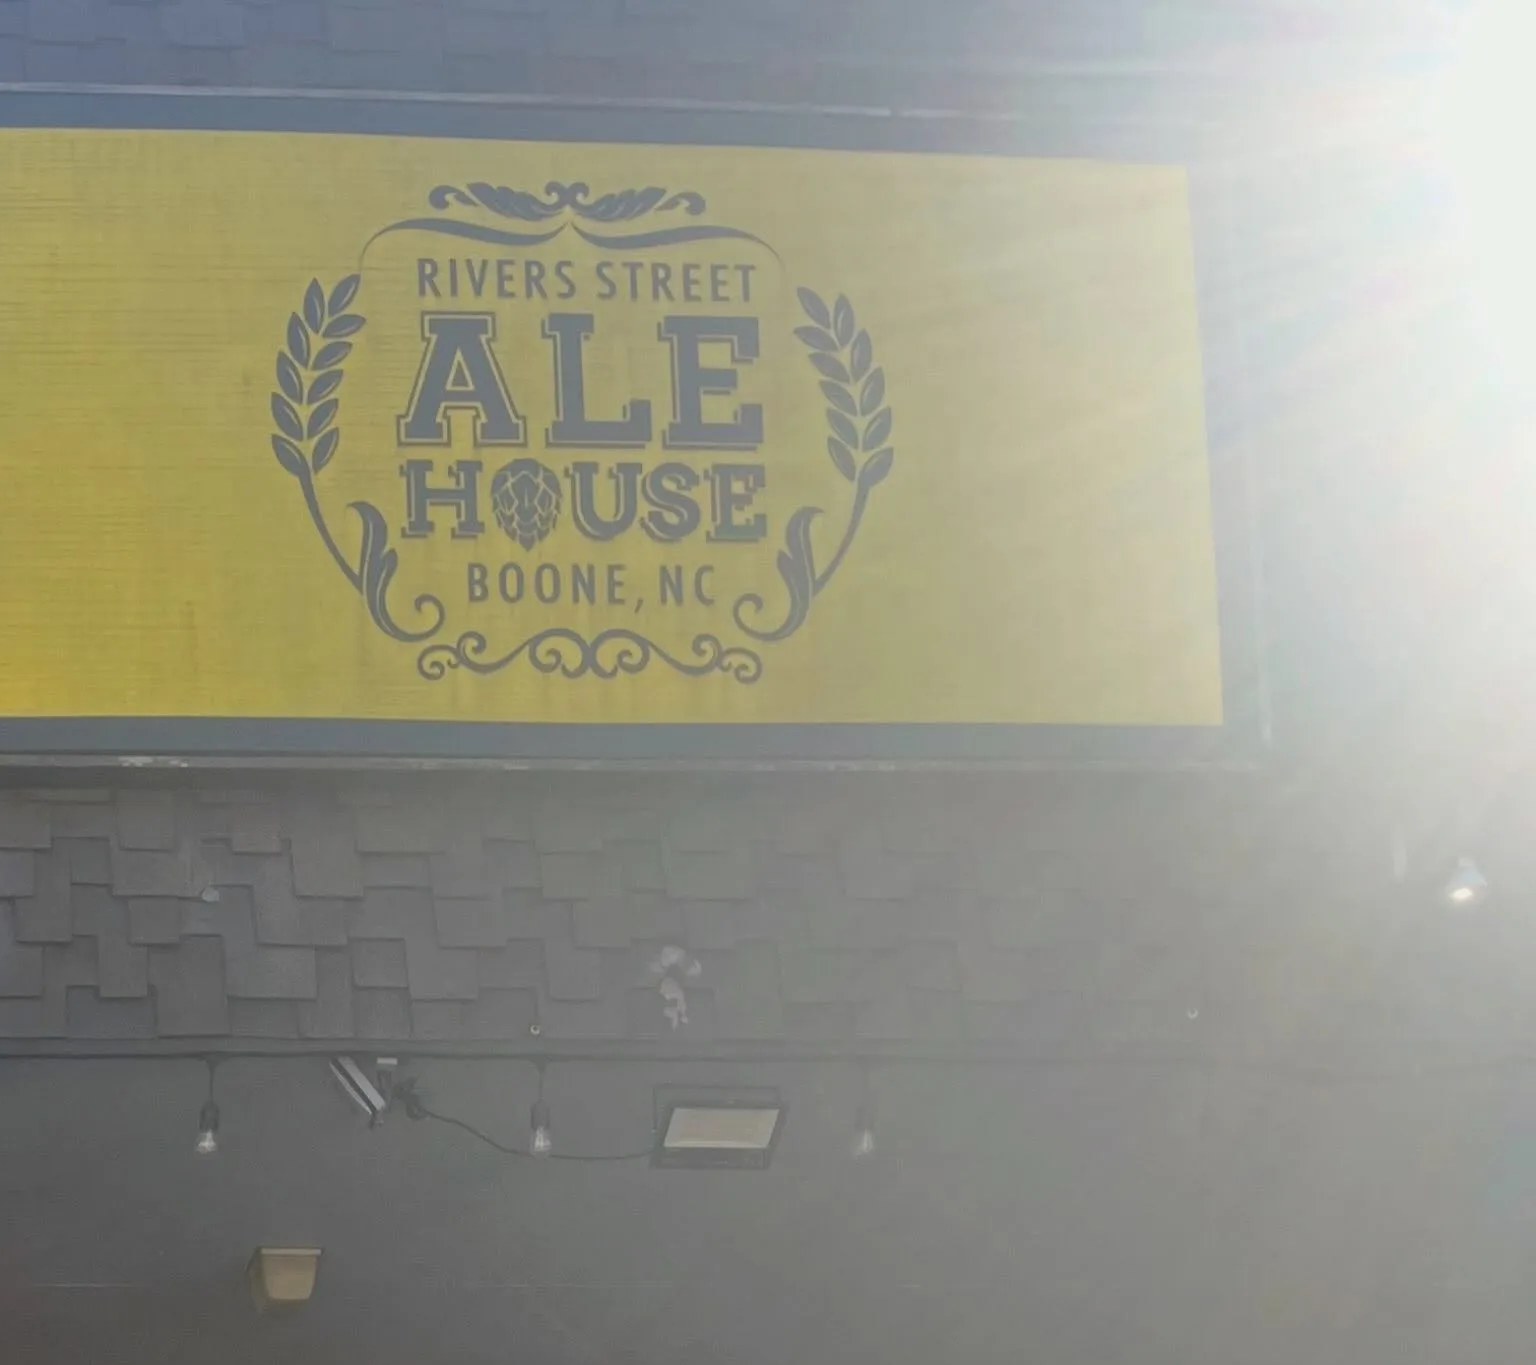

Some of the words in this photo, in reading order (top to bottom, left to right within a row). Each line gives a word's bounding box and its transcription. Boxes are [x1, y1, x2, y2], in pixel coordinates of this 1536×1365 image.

[417, 256, 577, 299] RIVERS
[596, 259, 757, 303] STREET
[396, 310, 766, 451] ALE
[399, 458, 768, 551] HOUSE
[466, 561, 646, 613] BOONE,
[659, 564, 717, 607] NC
